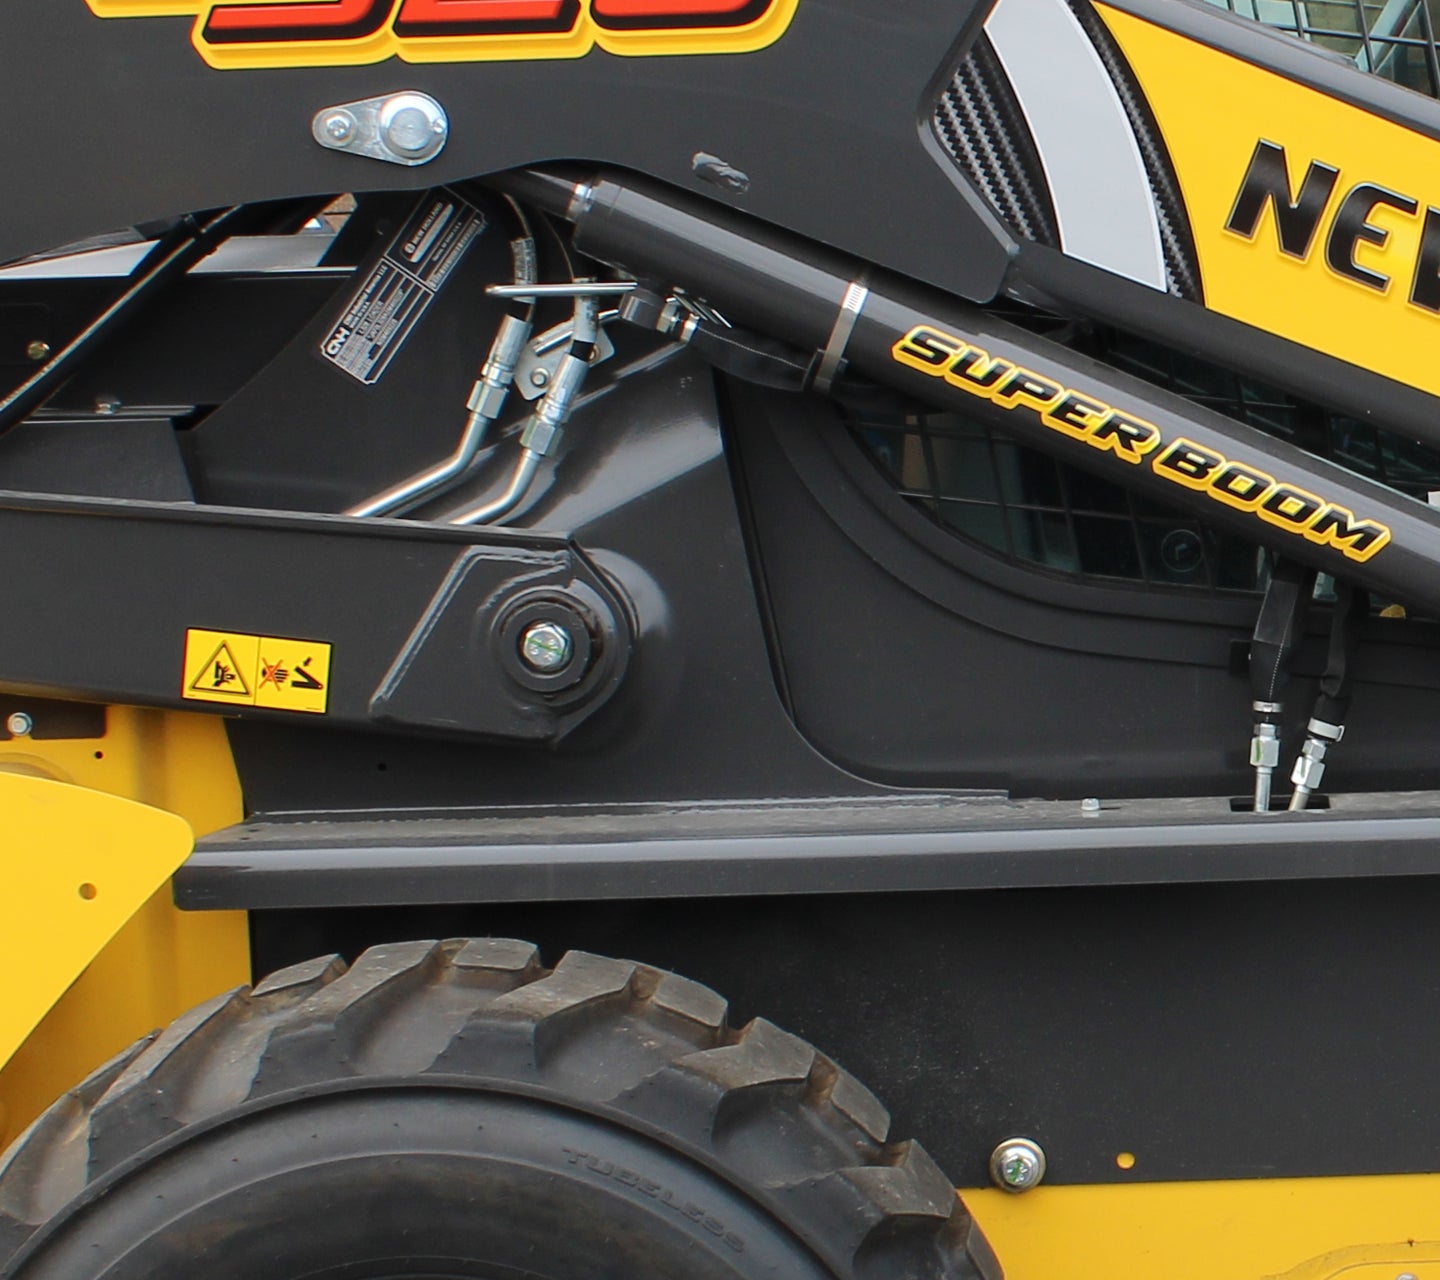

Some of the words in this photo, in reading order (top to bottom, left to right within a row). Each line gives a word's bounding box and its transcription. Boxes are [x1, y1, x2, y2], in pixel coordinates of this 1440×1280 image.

[893, 325, 1161, 464] SUPER
[1152, 437, 1392, 562] BOOM
[561, 1145, 746, 1254] TUBELESS
